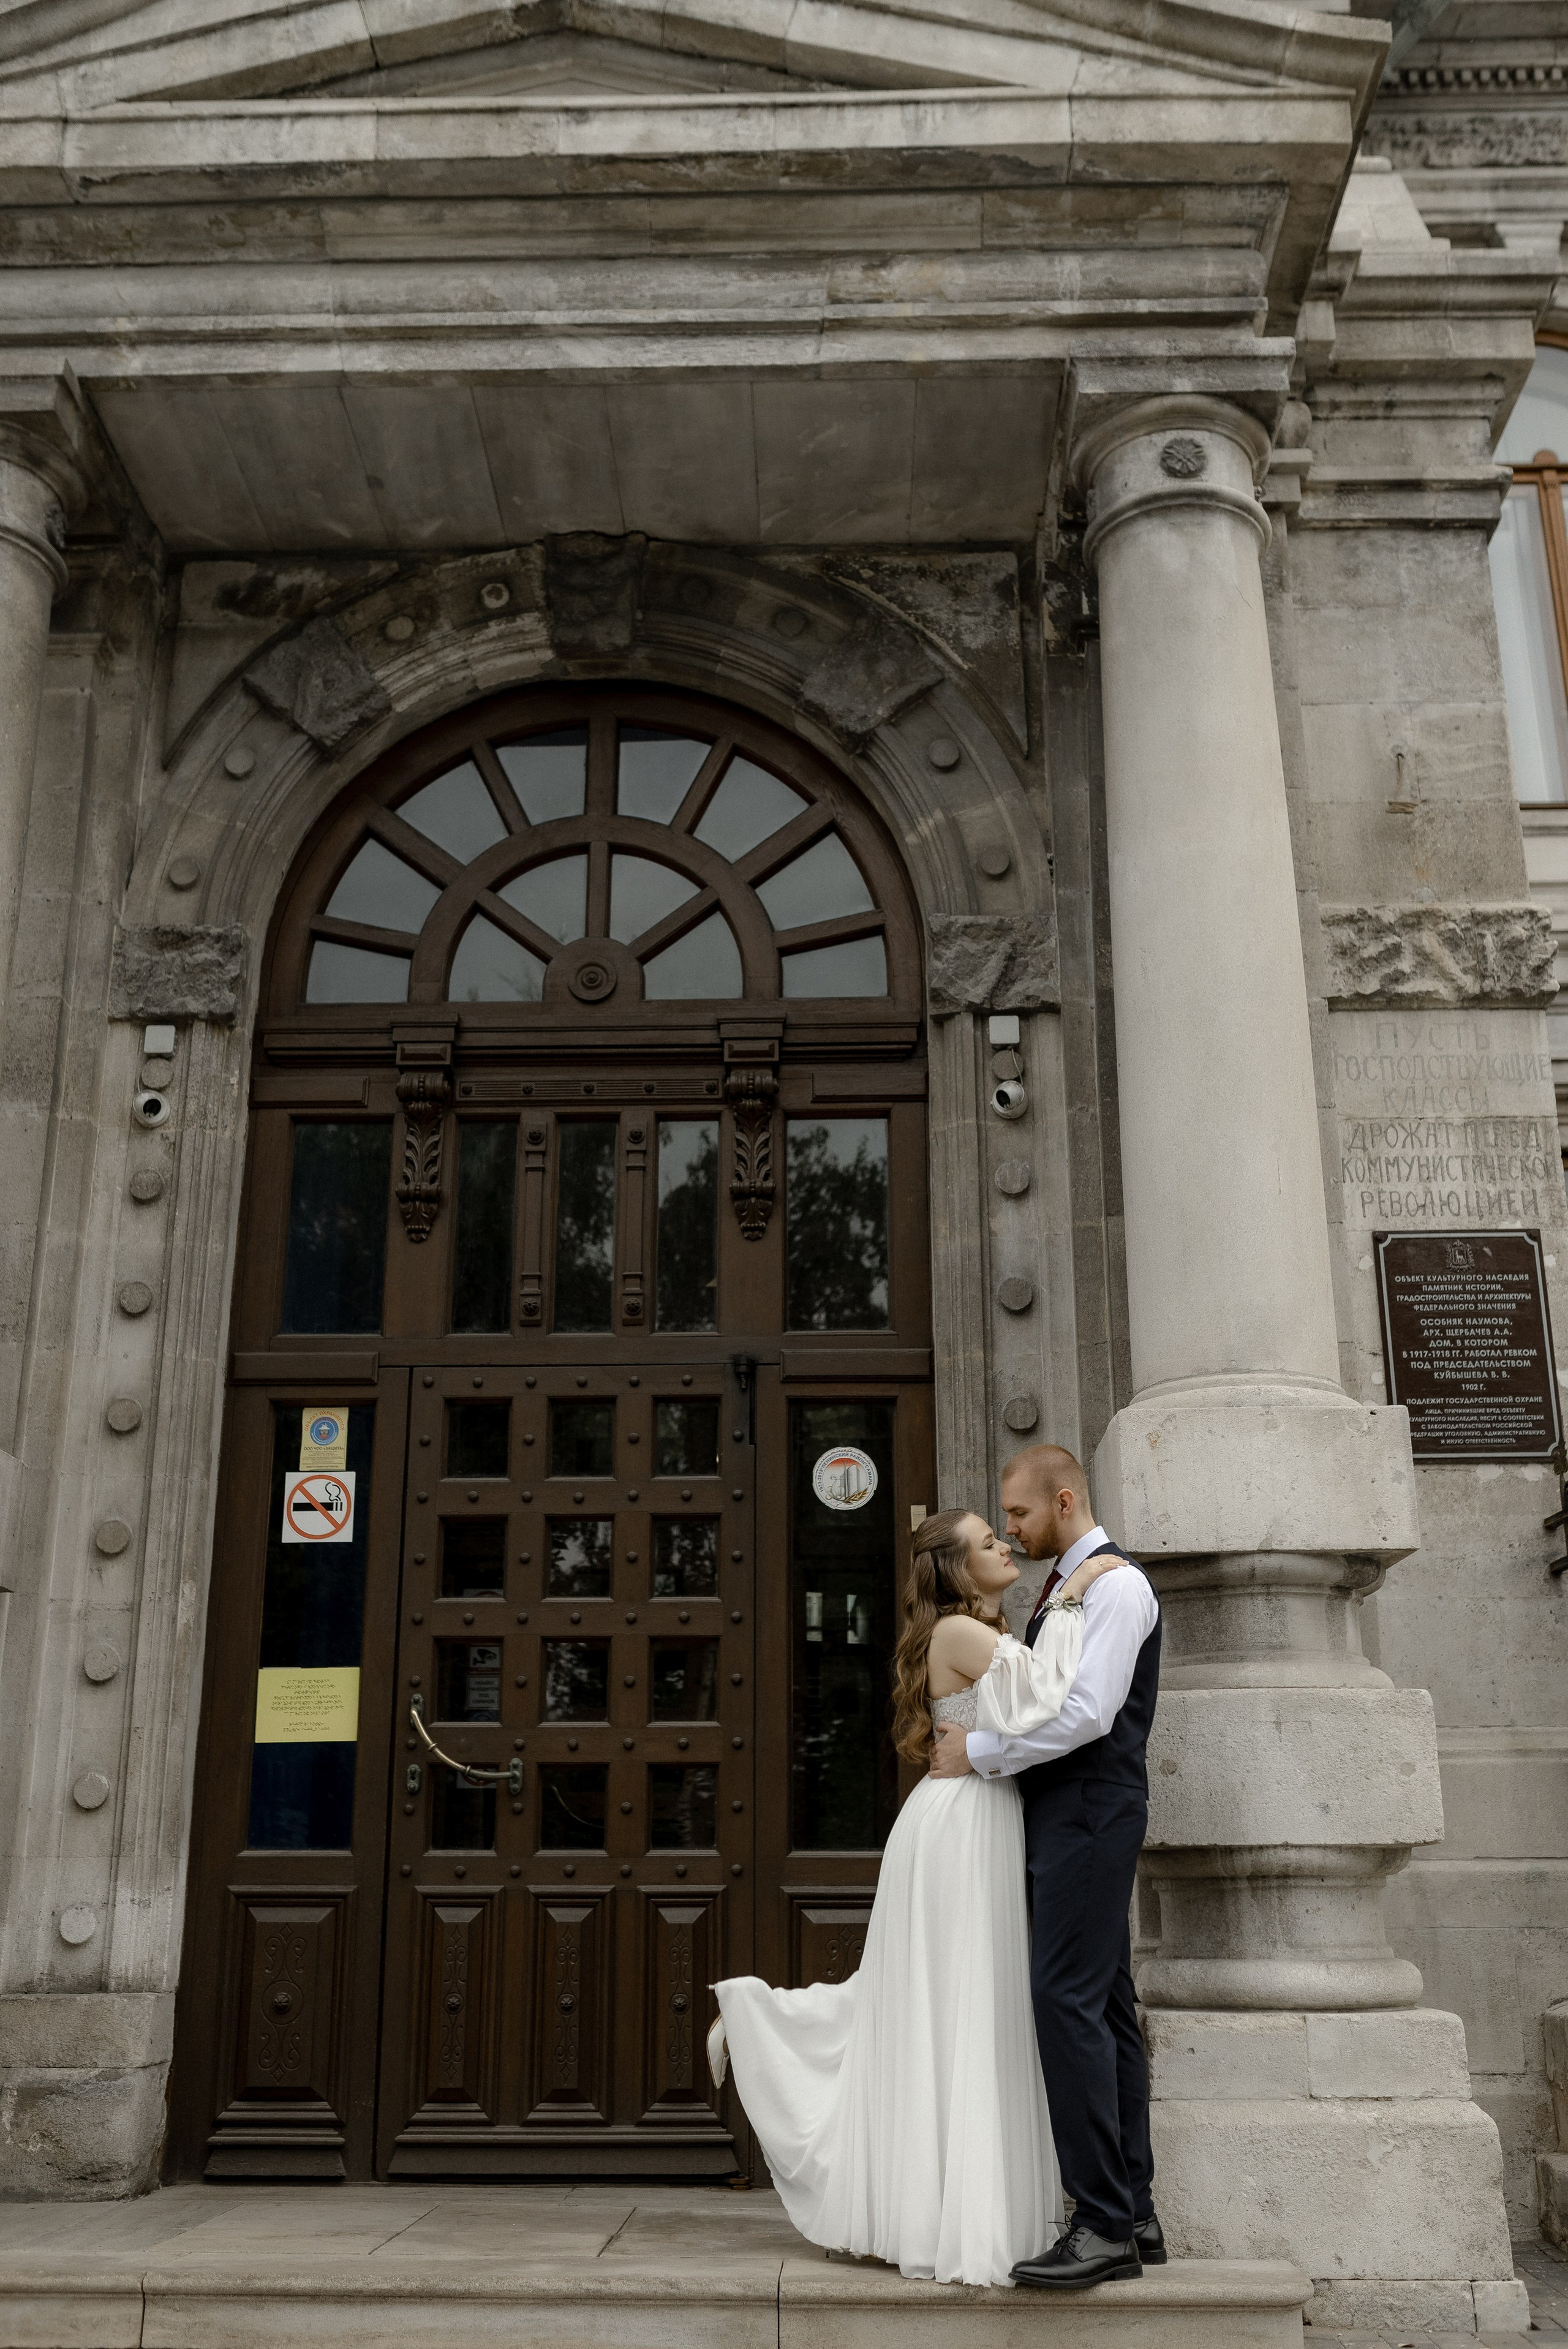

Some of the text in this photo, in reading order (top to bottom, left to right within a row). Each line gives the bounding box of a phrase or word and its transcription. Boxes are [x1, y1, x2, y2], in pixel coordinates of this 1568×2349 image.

[1375, 1022, 1490, 1050] ПУСТЬ
[1382, 1085, 1490, 1114] КЛАССЫ
[1348, 1120, 1542, 1152] ДРОЖАТ ПЕРЕД
[1429, 1340, 1453, 1348] ДОМ,
[1433, 1360, 1531, 1368] ПРЕДСЕДАТЕЛЬСТВОМ
[1434, 1370, 1488, 1379] КУЙБЫШЕВА
[1446, 1395, 1513, 1404] ГОСУДАРСТВЕННОЙ
